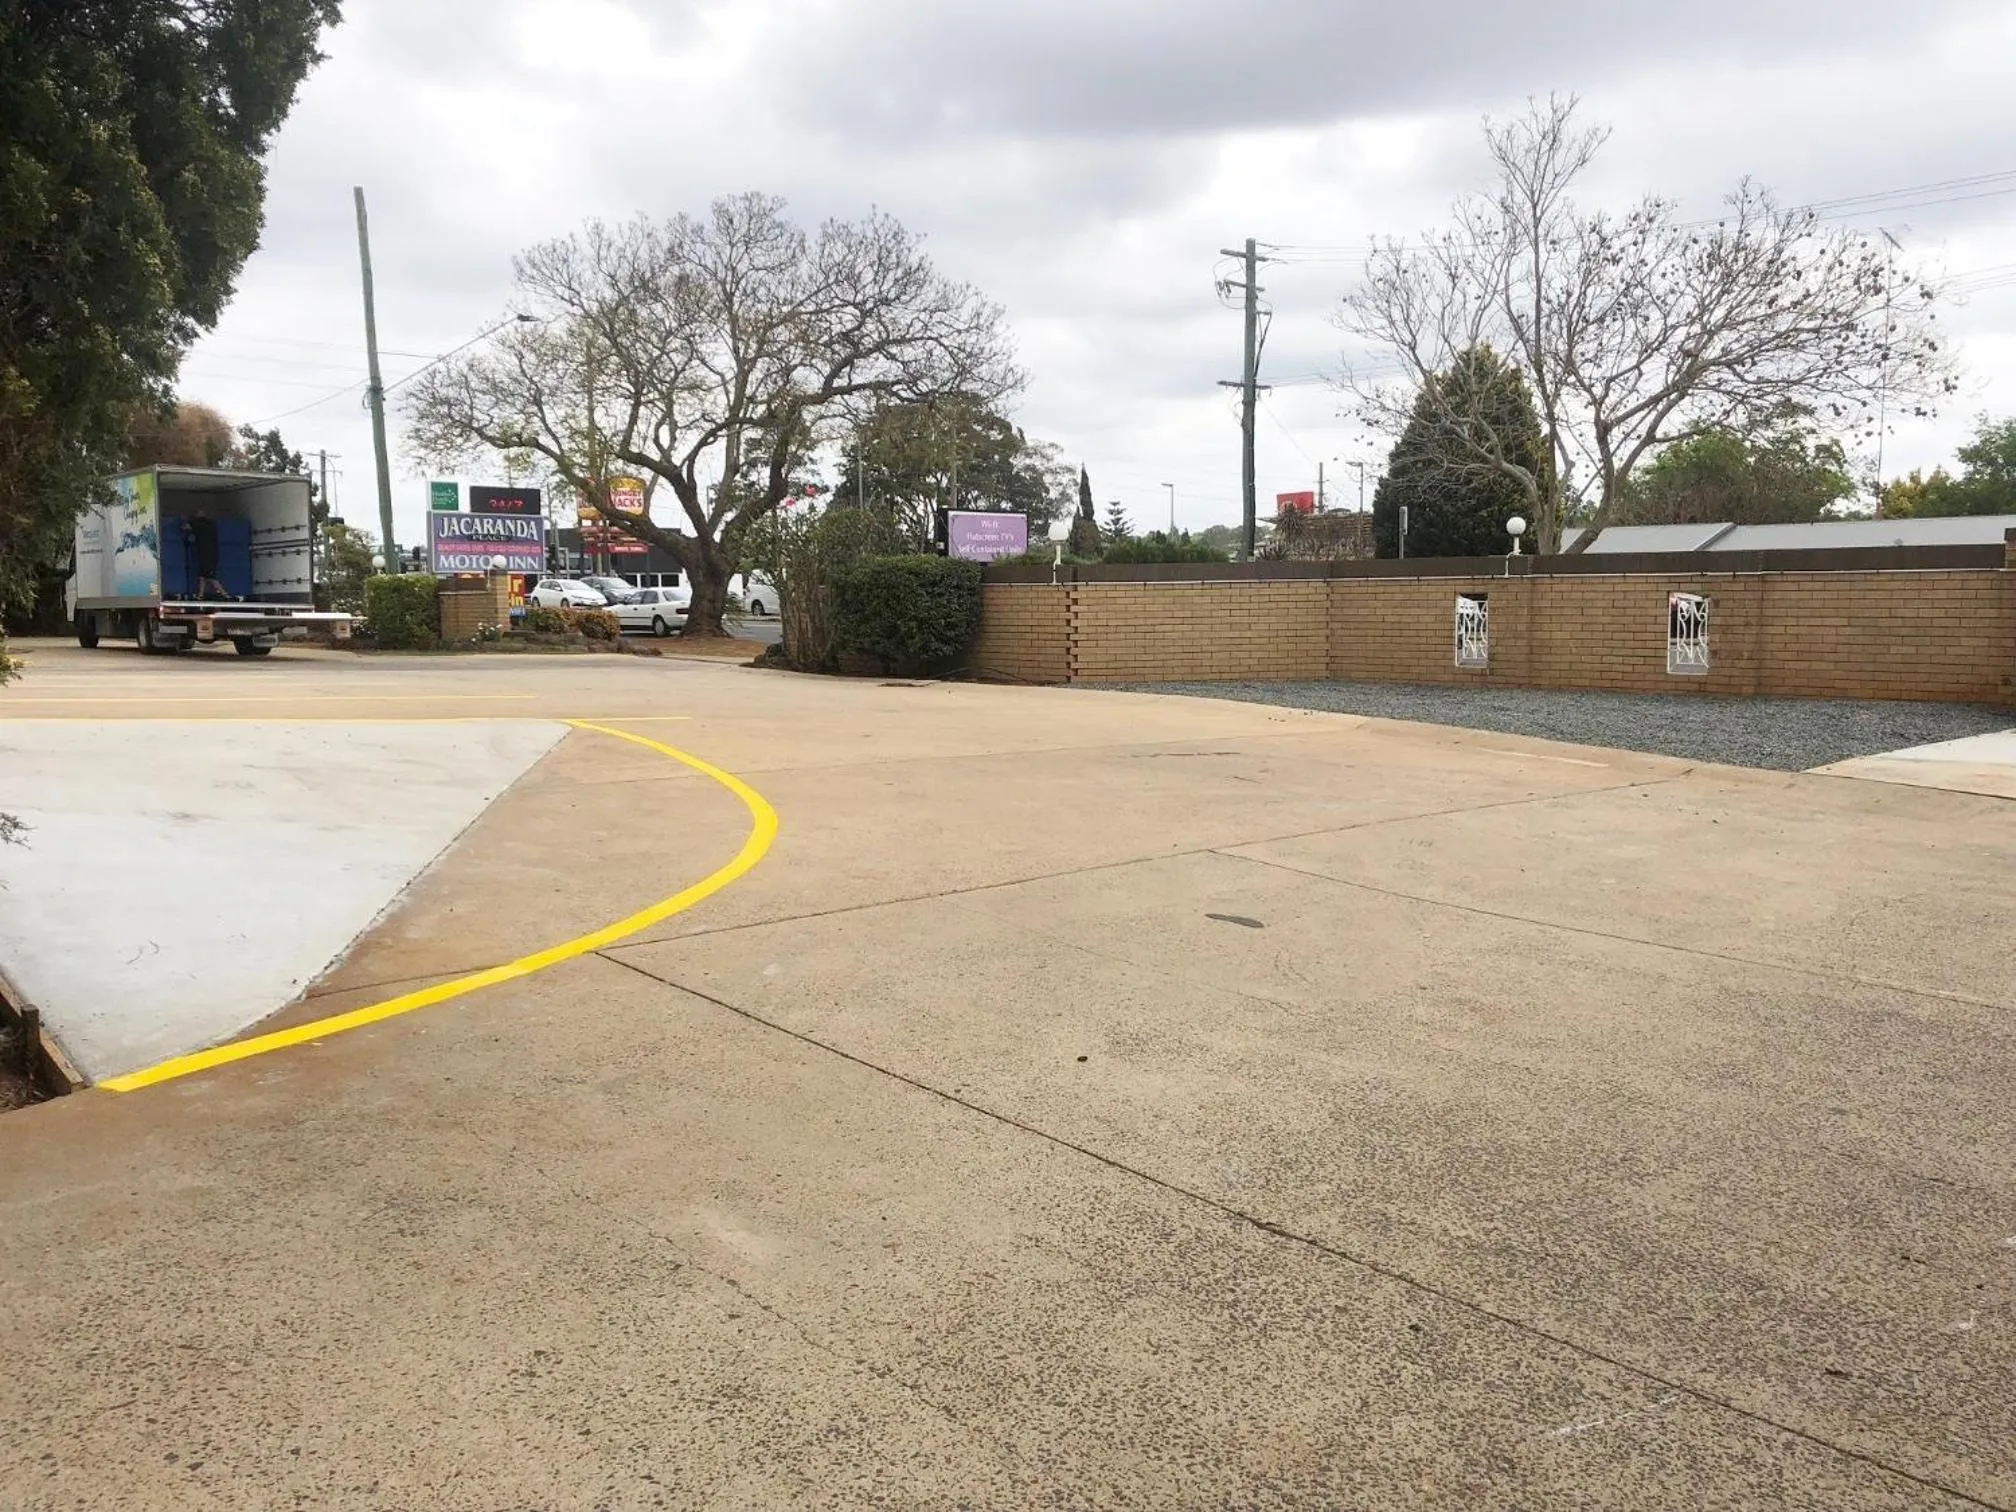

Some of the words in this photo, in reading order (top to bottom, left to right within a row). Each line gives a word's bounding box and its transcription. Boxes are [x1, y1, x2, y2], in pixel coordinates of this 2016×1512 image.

[439, 517, 539, 541] JACARANDA
[440, 555, 503, 569] MOTO
[509, 556, 540, 570] INN
